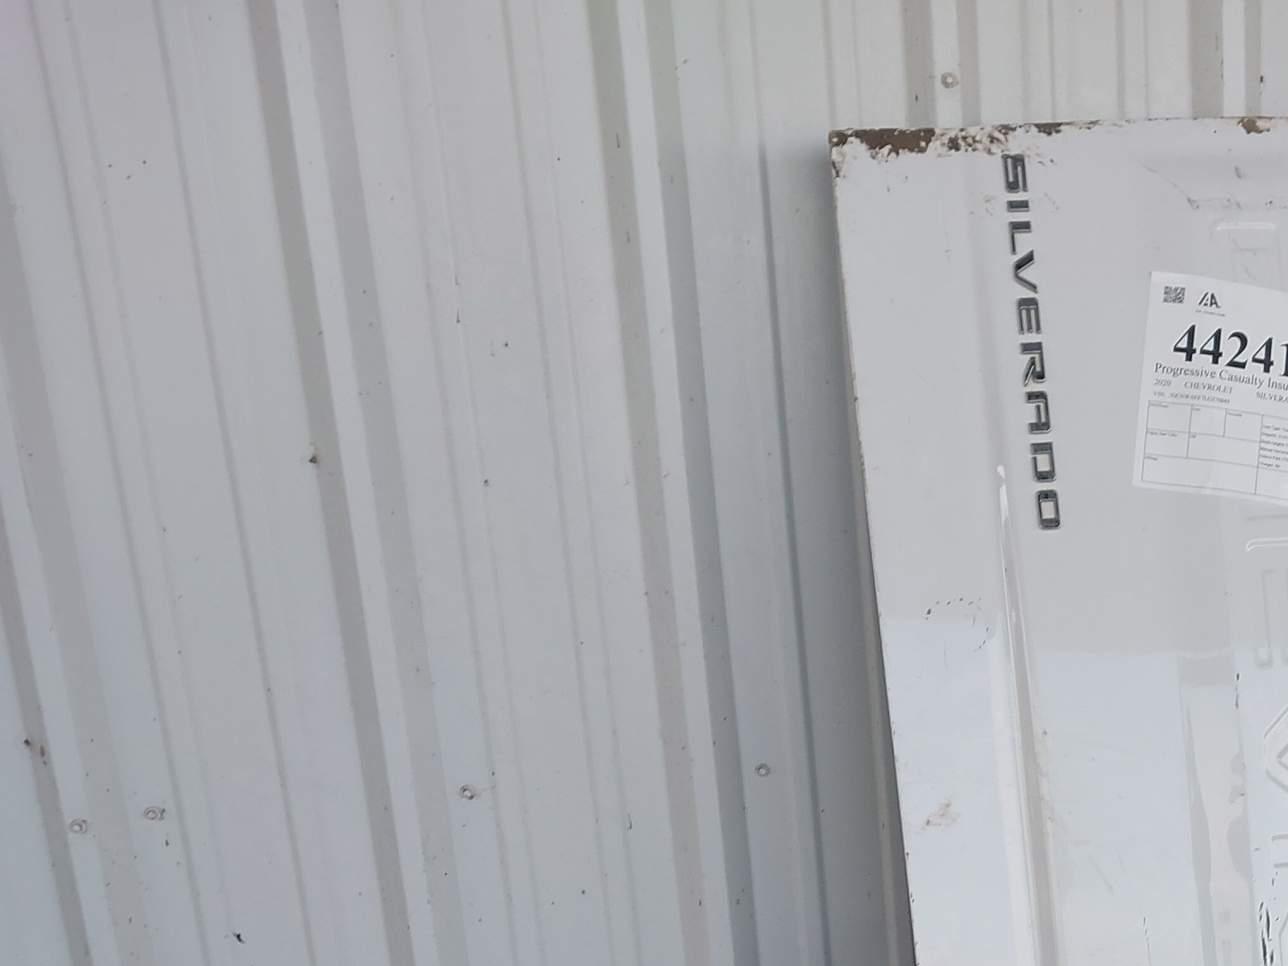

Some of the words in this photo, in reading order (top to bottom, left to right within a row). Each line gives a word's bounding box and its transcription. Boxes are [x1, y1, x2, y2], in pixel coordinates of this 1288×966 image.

[1001, 152, 1062, 530] SILVERADO
[1154, 362, 1217, 380] Progressive
[1218, 369, 1264, 389] Casualty
[1183, 381, 1234, 395] CHEVROLET
